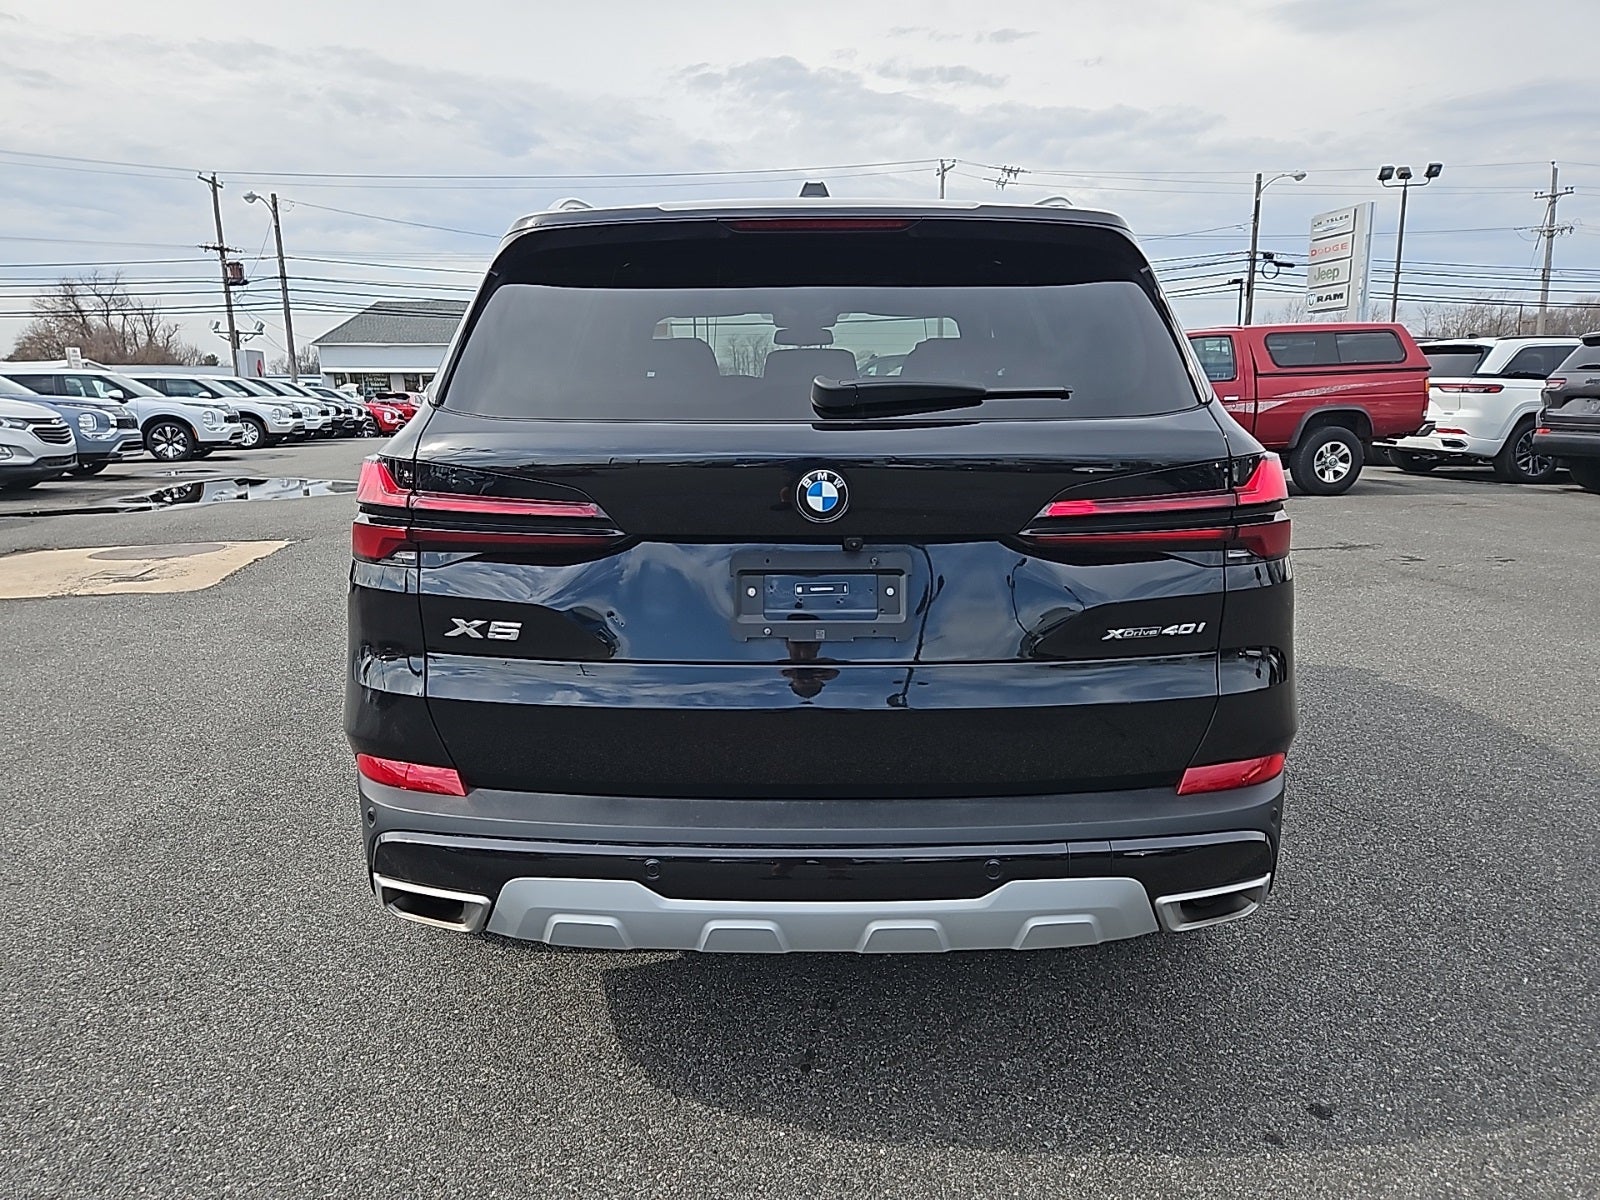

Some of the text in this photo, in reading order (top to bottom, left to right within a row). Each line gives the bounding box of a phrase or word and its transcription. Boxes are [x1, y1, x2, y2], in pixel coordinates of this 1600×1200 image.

[1310, 242, 1349, 257] DODGE
[1314, 267, 1340, 281] Jeep
[1316, 292, 1344, 303] RAM
[802, 472, 844, 489] BMW
[443, 617, 523, 641] X5
